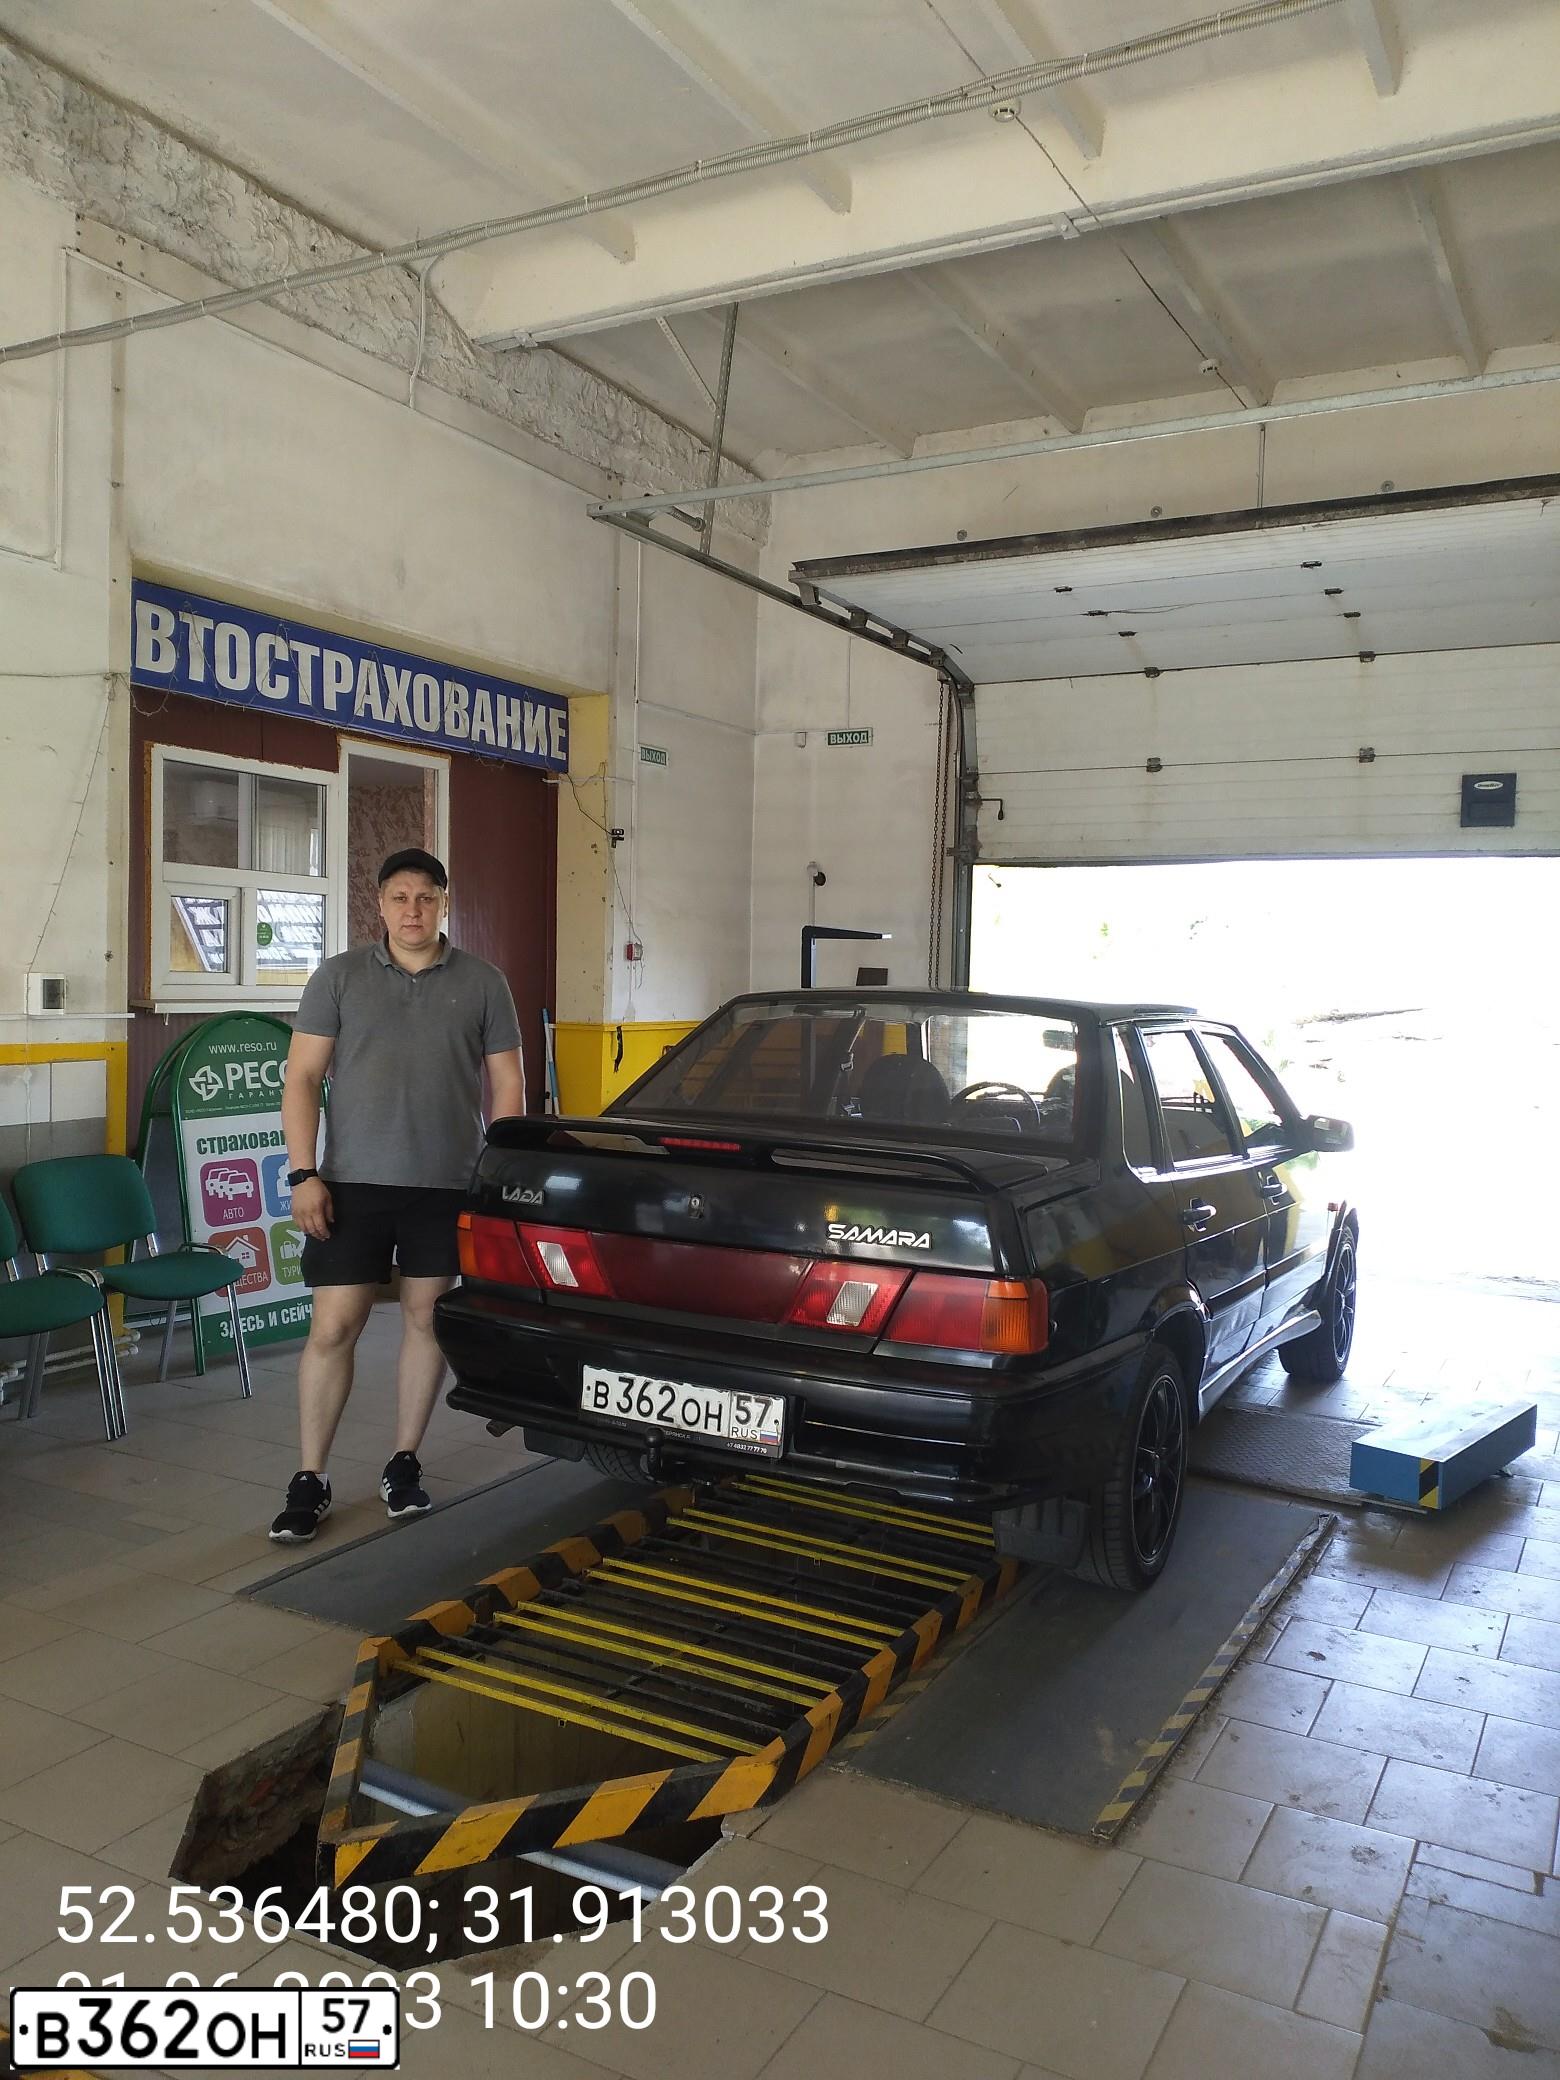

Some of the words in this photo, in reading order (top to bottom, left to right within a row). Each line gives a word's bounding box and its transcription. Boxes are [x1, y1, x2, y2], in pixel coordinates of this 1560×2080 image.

[135, 599, 568, 761] ВТОСТРАХОВАНИЕ
[829, 729, 868, 746] ВЫХОД
[640, 747, 667, 766] ВЫХОД
[208, 1040, 277, 1055] www.reso.ru
[501, 1185, 545, 1205] LADA
[222, 1207, 244, 1220] АВТО
[828, 1223, 931, 1249] SAMARA
[268, 1311, 278, 1328] И
[593, 1376, 724, 1432] В362ОН
[735, 1394, 773, 1428] 57
[731, 1427, 758, 1440] RUS
